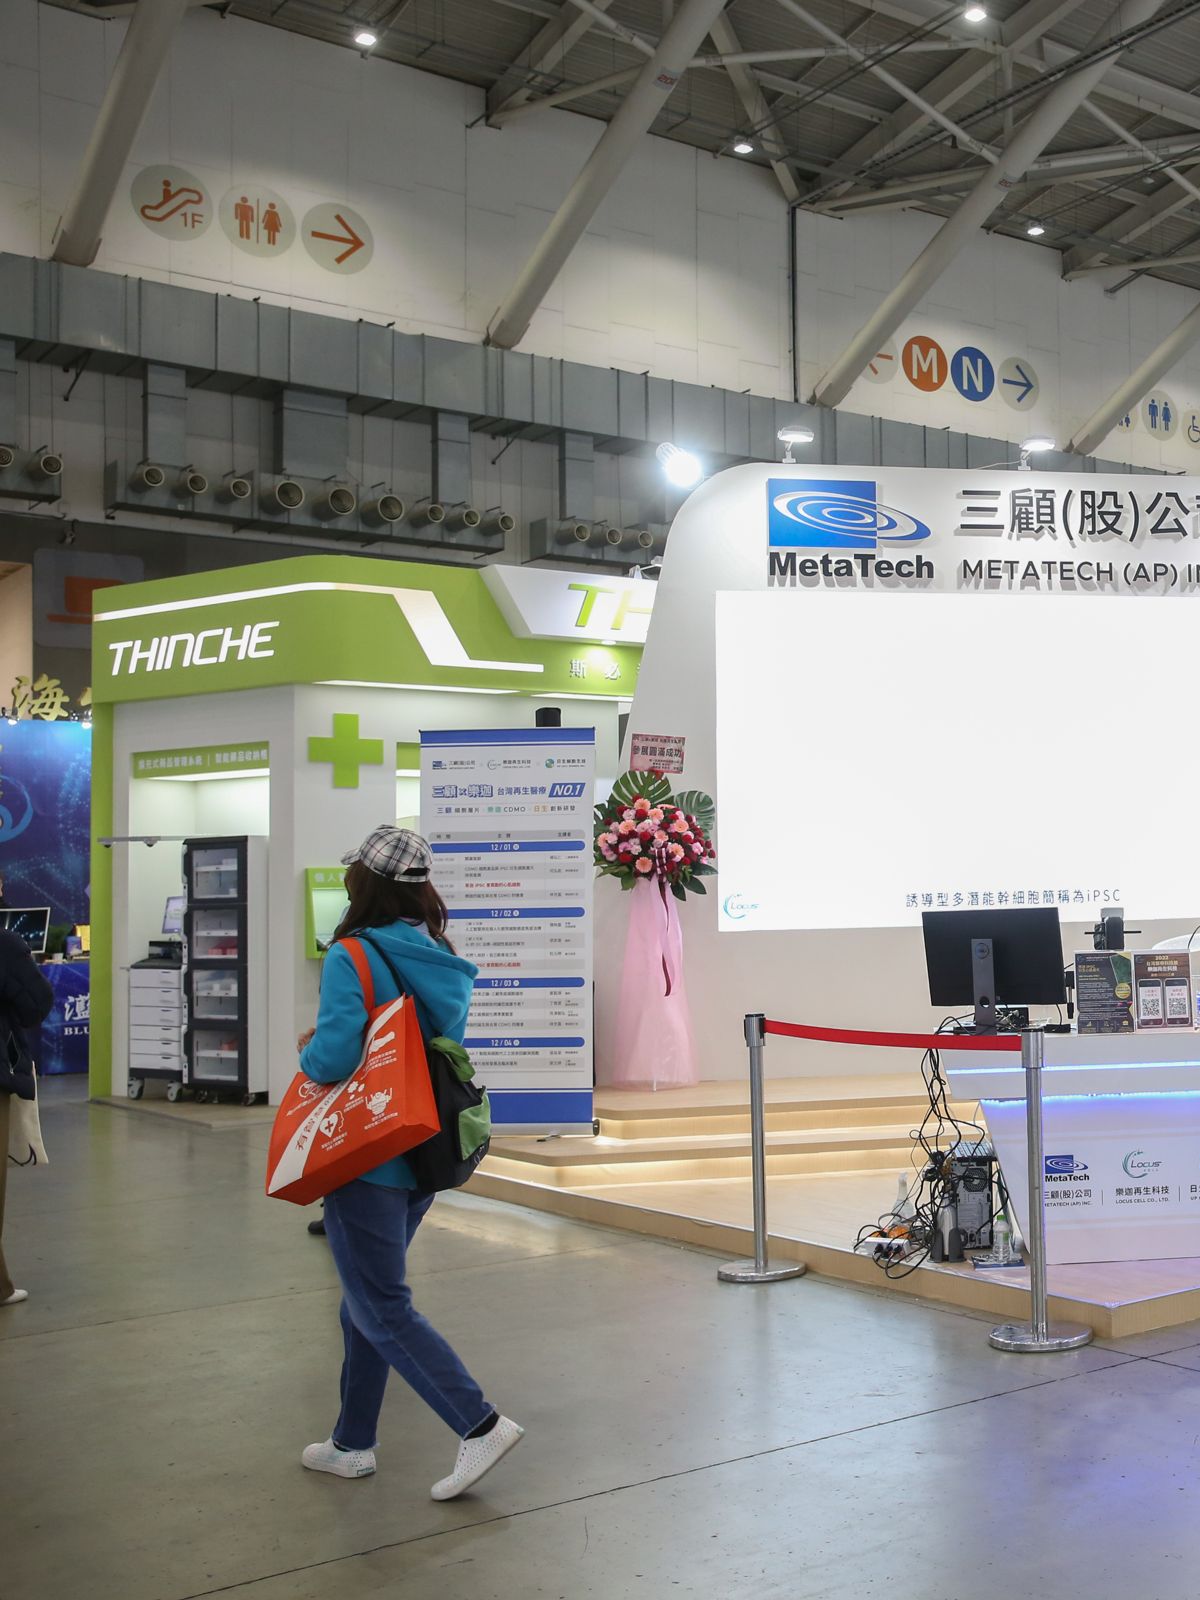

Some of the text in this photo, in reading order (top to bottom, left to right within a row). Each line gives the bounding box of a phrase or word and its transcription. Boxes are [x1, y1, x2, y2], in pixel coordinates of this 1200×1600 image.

[181, 212, 204, 229] 1F
[911, 344, 939, 384] M
[962, 356, 983, 393] N
[769, 552, 934, 579] MetaTech
[963, 559, 1113, 582] METATECH
[1123, 561, 1178, 586] (AP)
[109, 621, 280, 677] THINCHE
[553, 784, 581, 797] NO.1
[1045, 1174, 1090, 1182] MetaTech
[1115, 1185, 1170, 1196] 樂迦再生科技
